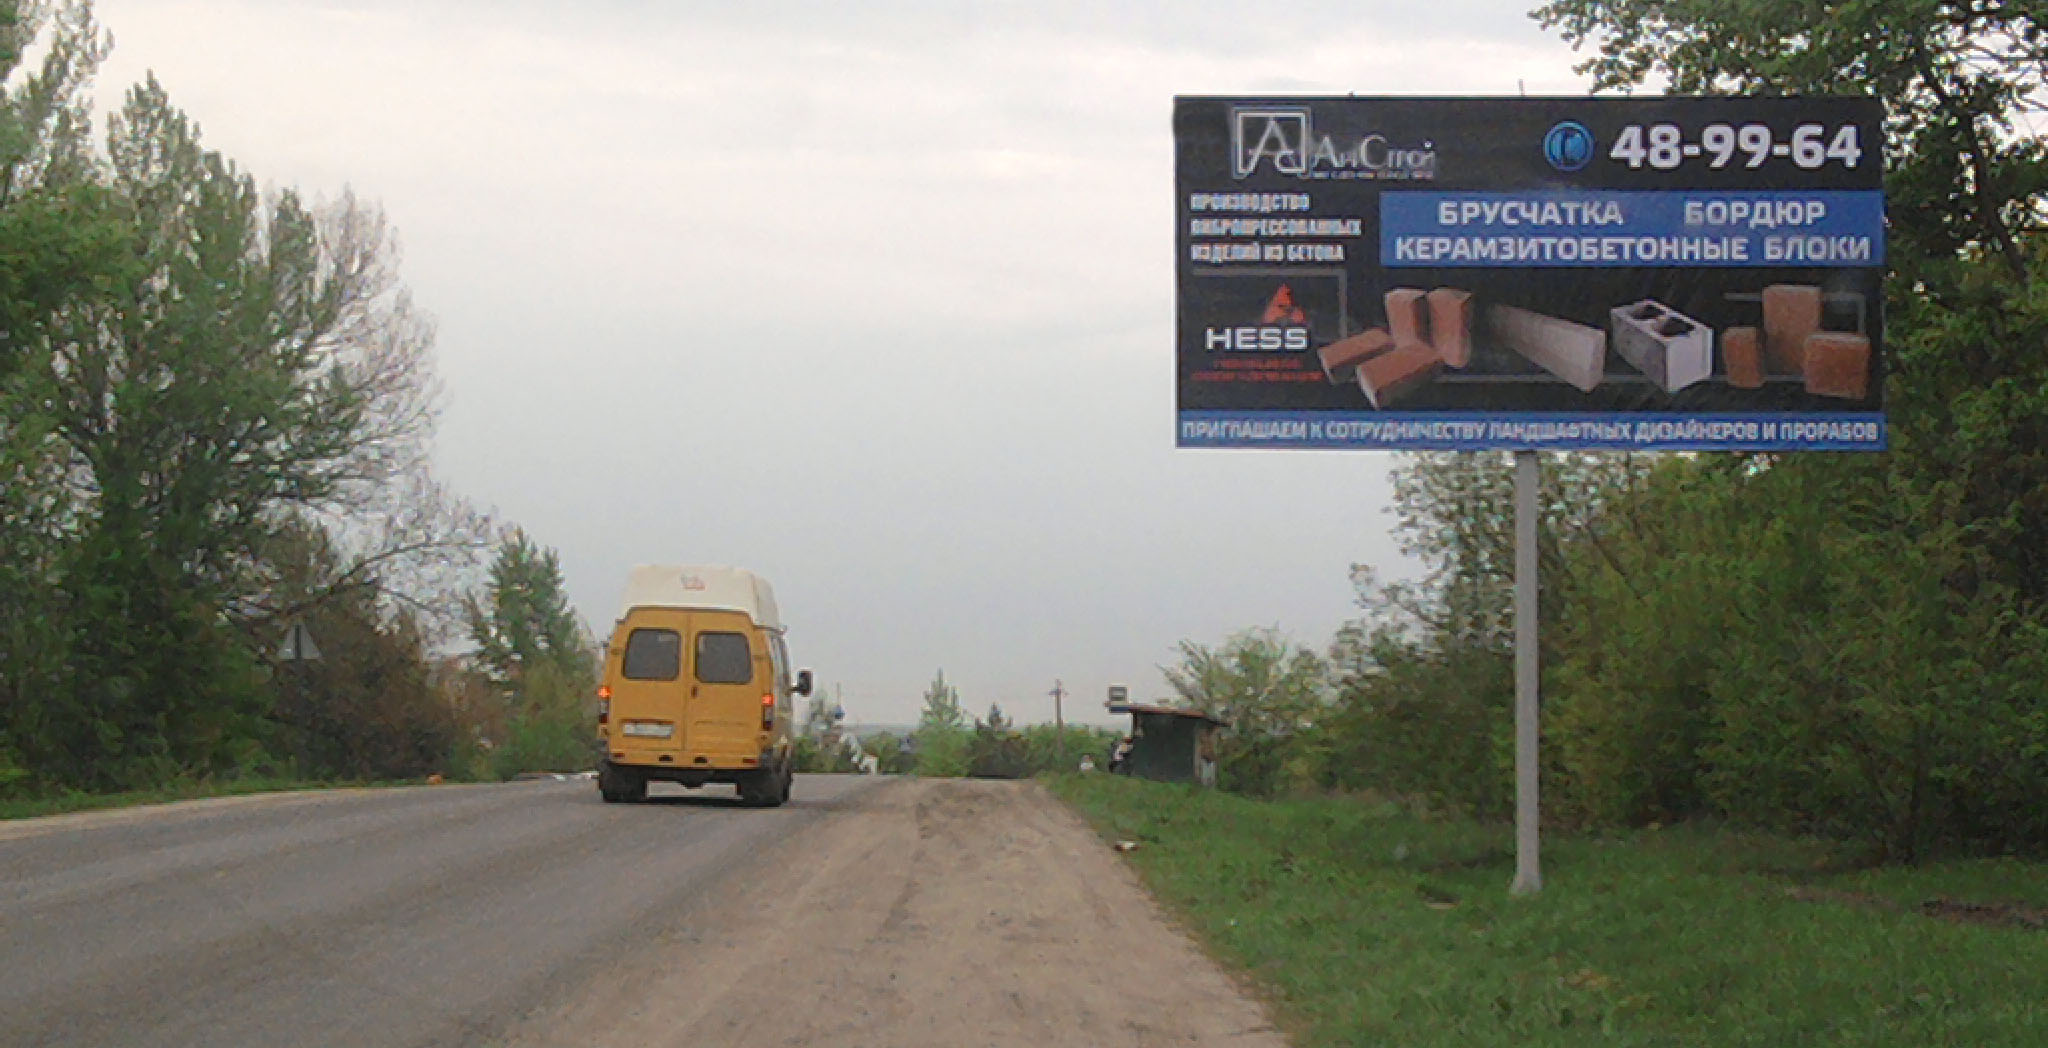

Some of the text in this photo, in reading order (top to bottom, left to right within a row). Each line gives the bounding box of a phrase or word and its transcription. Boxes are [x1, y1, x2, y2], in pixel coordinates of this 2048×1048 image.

[1608, 124, 1863, 168] 48-99-64
[1437, 201, 1826, 229] БРУСЧАТКА БОРДЮР
[1395, 236, 1872, 261] КЕРАМЗИТОБЕТОННЫЕ БЛОКИ
[1205, 327, 1308, 350] HESS
[1182, 420, 1878, 443] ПРИГЛАШАЕМ К СОТРУДНИЧЕСТВУ ЛАНДШАФТНЫХ ДИЗАЙНЕРОВ И ПРОРАБОВ
